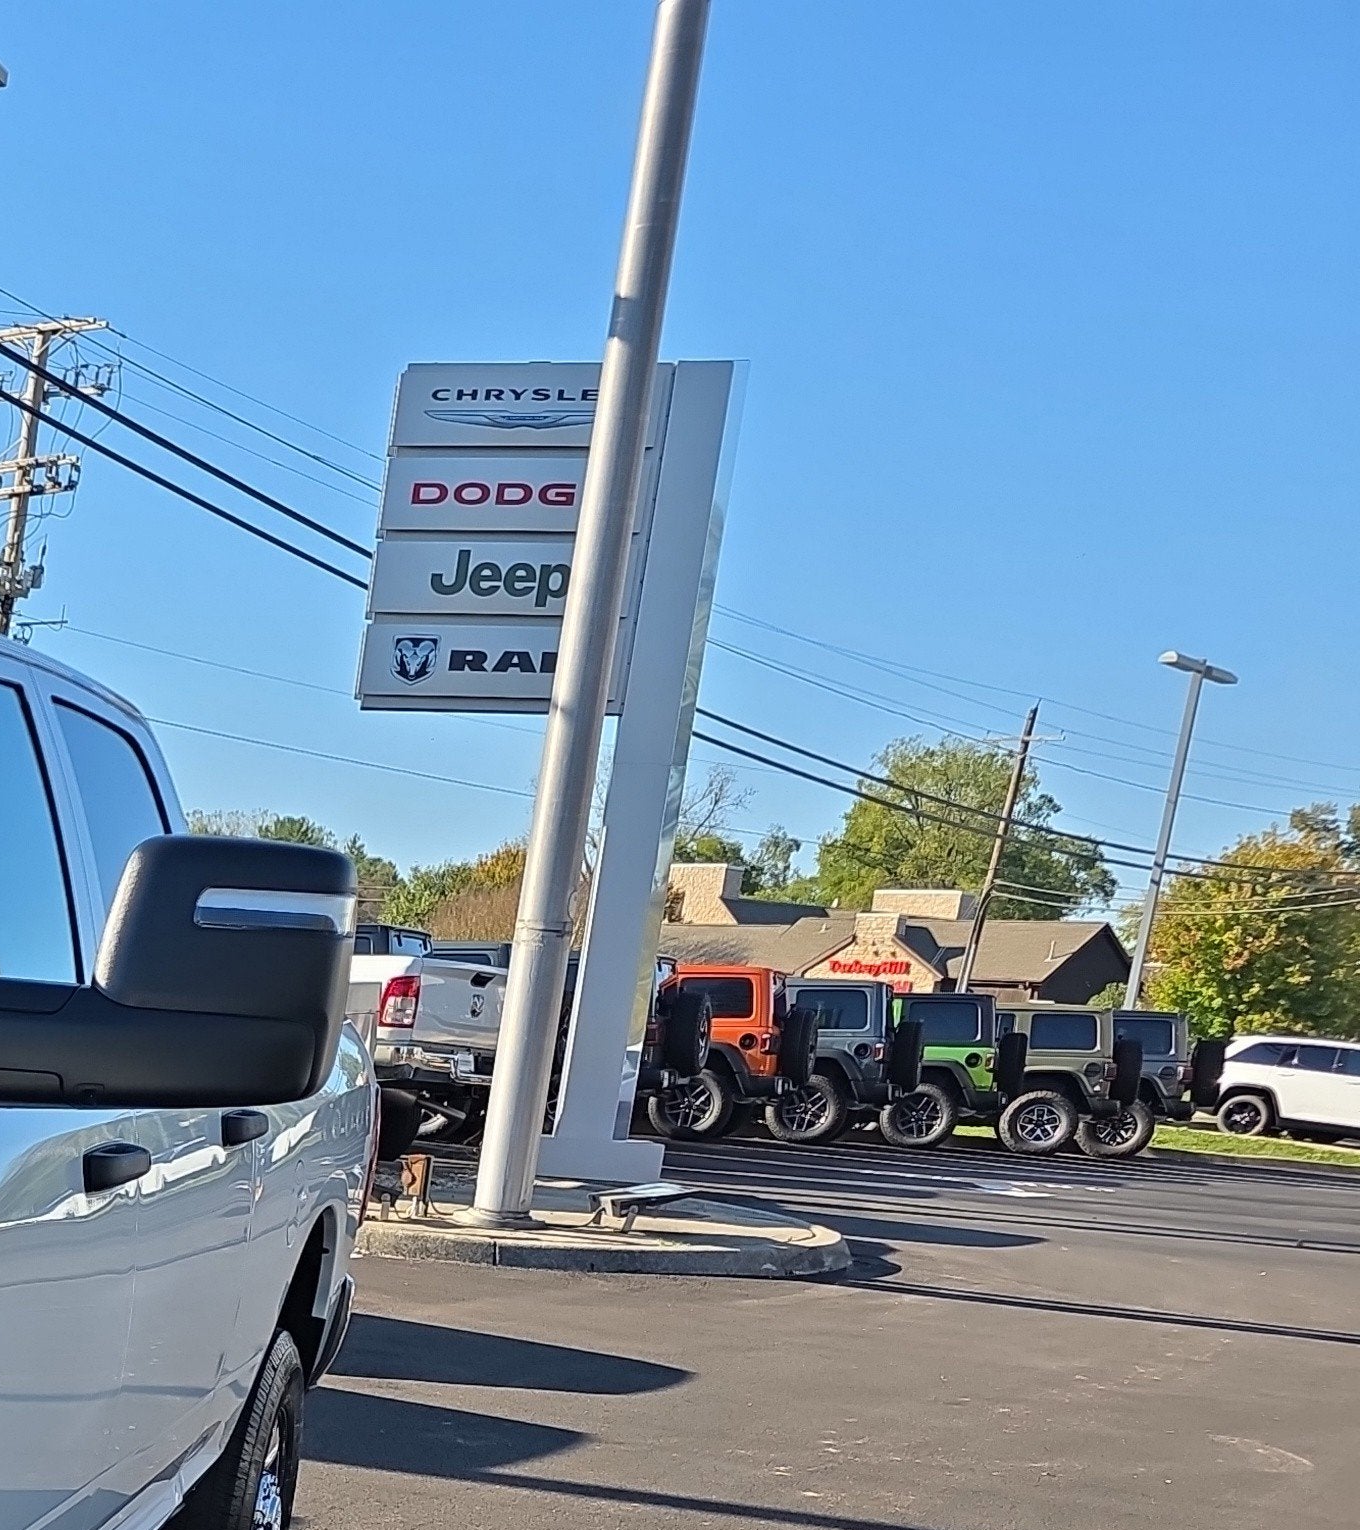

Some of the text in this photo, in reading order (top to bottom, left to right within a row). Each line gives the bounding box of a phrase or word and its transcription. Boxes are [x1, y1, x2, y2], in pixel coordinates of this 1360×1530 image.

[431, 388, 599, 402] CHRYSLE
[411, 482, 576, 506] DODG
[431, 549, 571, 608] Jeep
